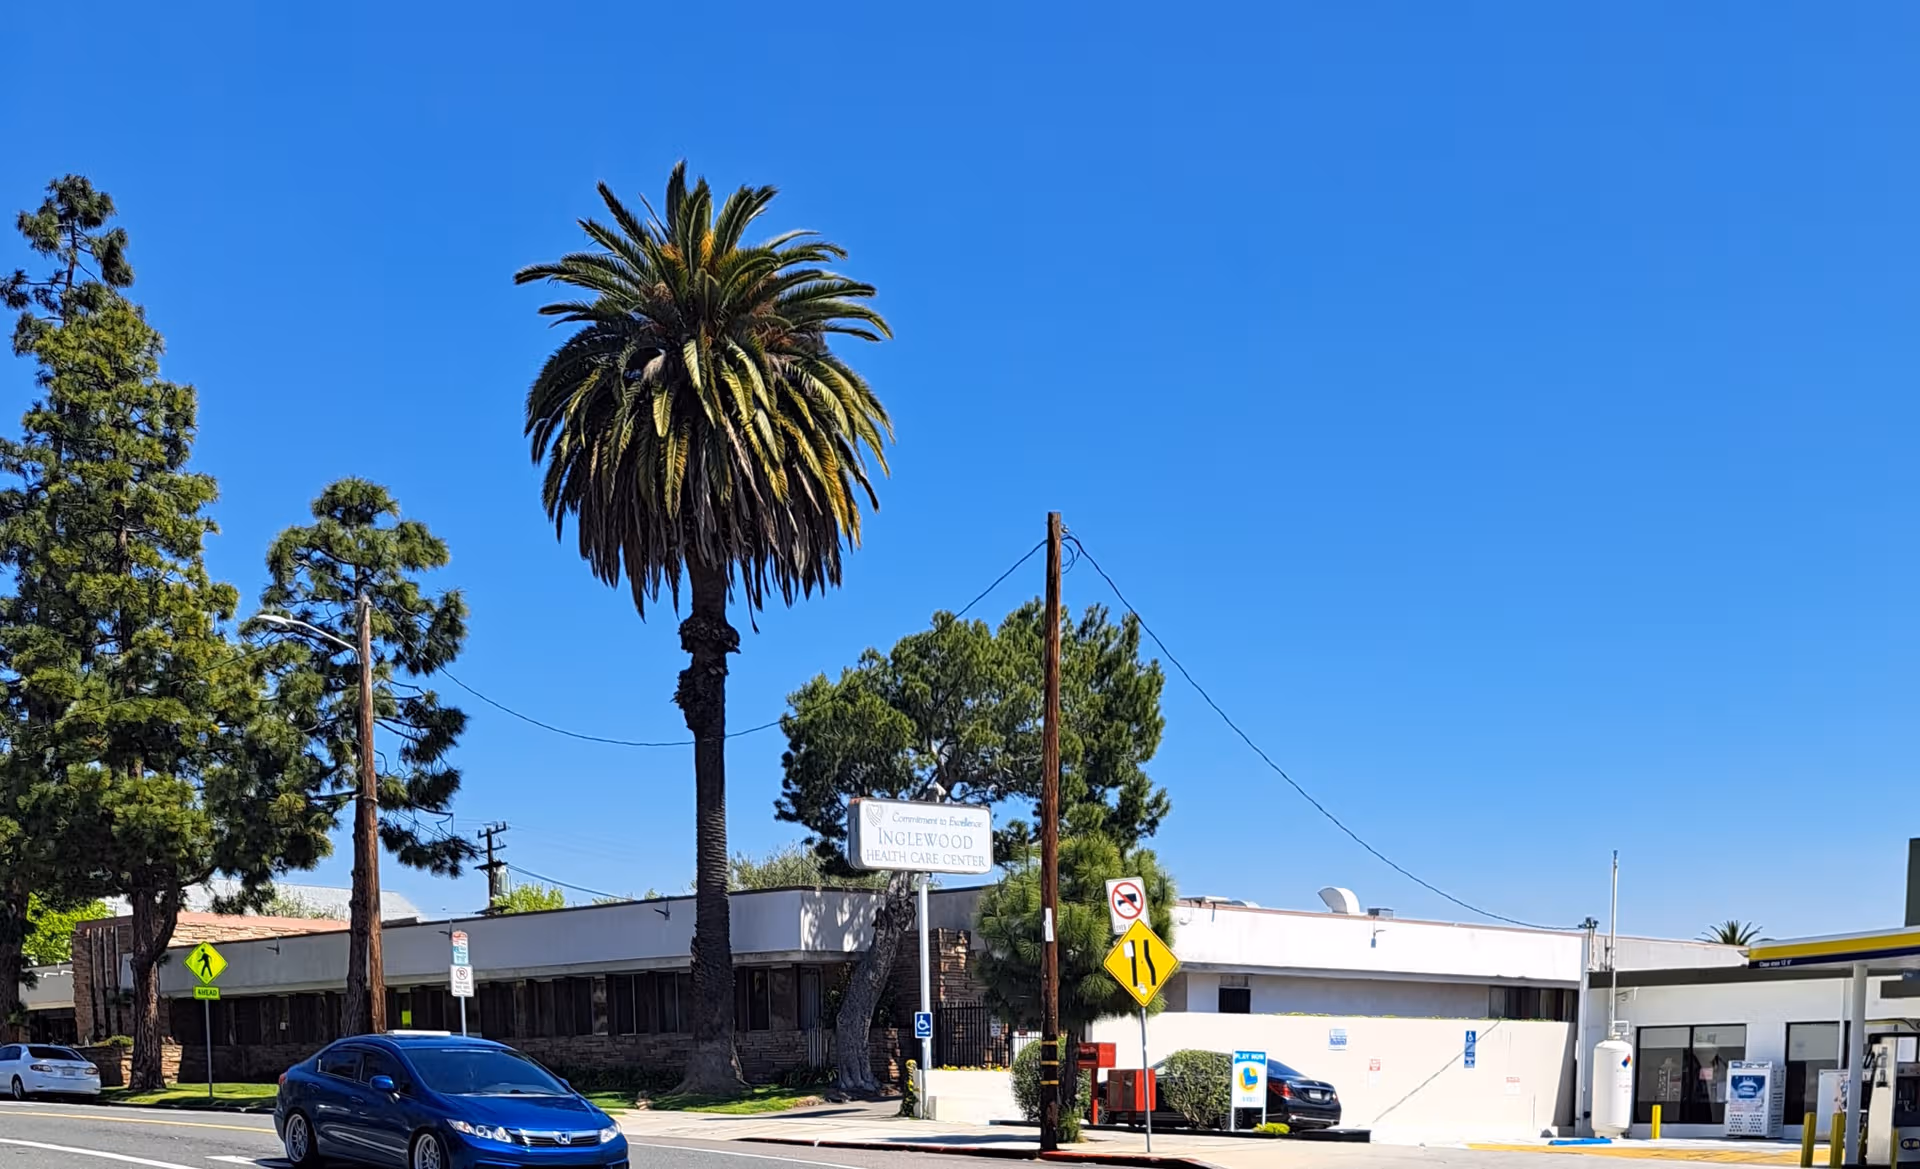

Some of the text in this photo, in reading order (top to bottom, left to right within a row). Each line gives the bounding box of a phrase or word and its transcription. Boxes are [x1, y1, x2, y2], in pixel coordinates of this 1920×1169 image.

[892, 812, 982, 828] Commitment to Excellence
[879, 828, 973, 849] INGLEWOOD
[866, 849, 986, 867] HEALTH CARE CENTER
